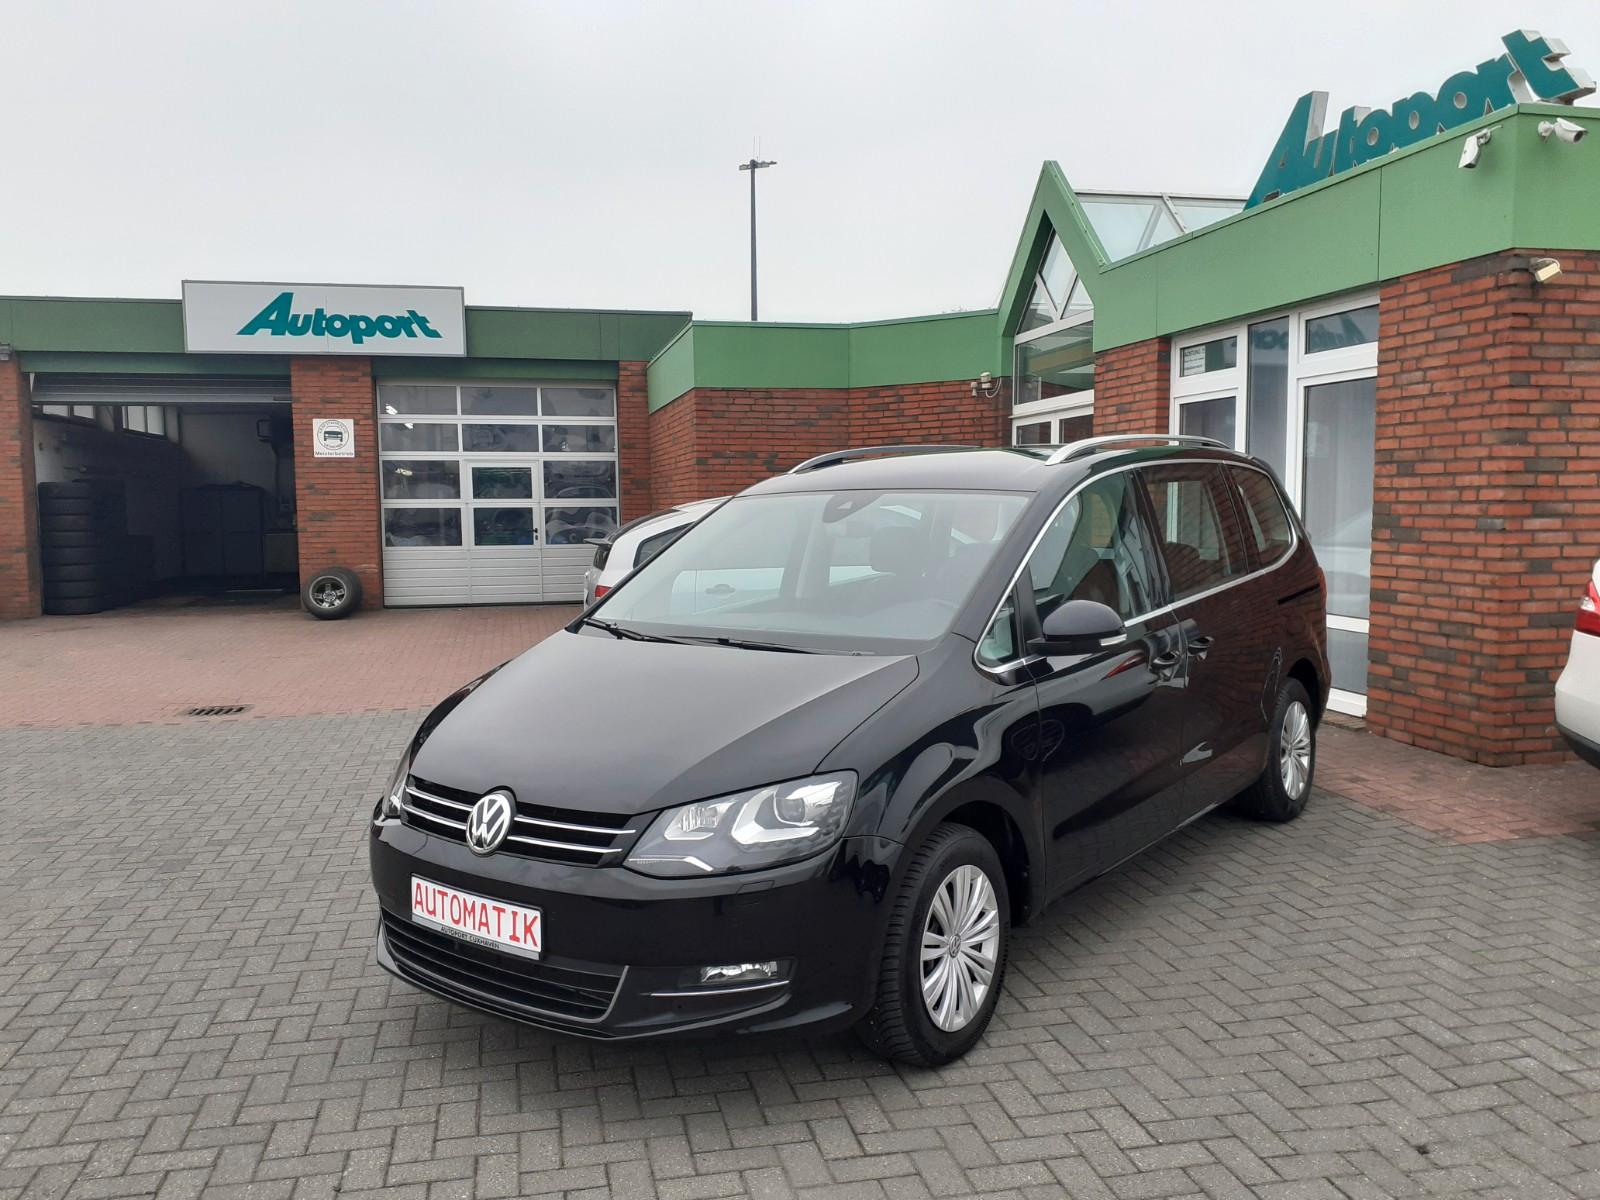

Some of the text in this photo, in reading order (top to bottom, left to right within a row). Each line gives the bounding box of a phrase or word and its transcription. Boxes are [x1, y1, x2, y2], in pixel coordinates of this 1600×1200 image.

[1242, 29, 1596, 212] Autoport
[236, 291, 443, 345] Autoport
[414, 882, 539, 948] AUTOMATIK
